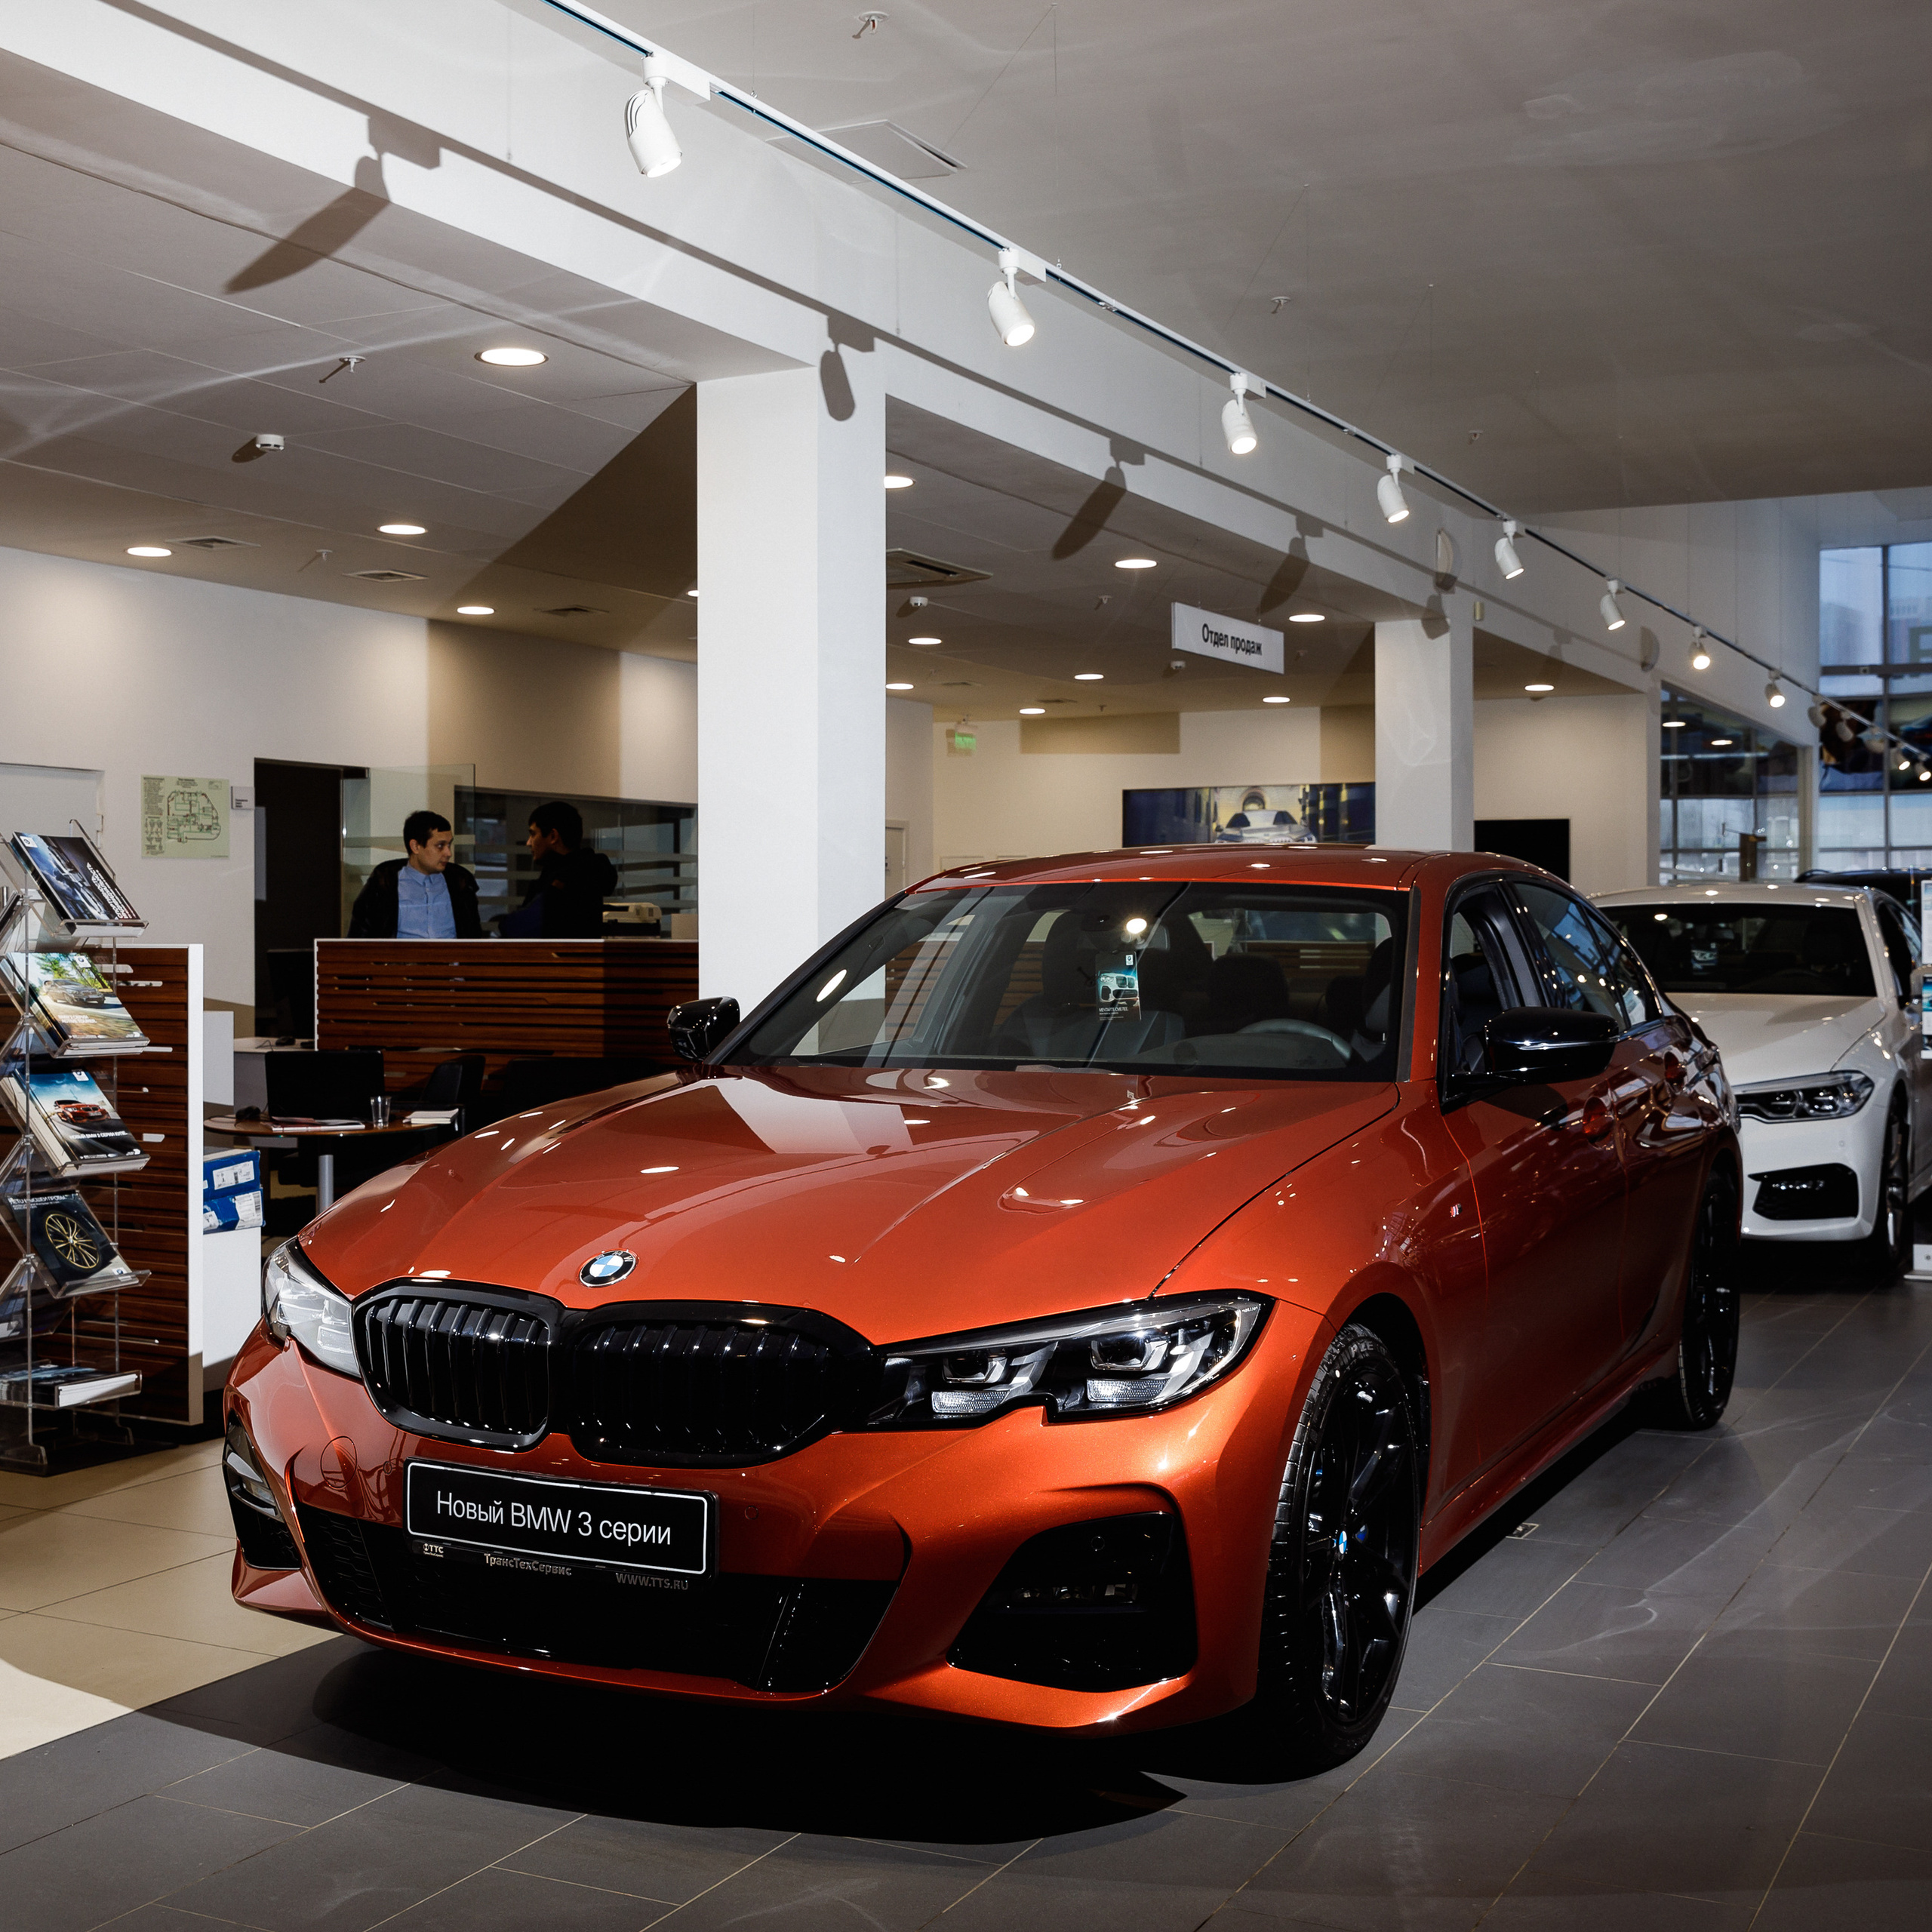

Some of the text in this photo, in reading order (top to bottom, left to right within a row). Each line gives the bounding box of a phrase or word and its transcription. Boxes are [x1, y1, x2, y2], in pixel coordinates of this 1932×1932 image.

[1201, 623, 1263, 656] Отдел продаж
[437, 1490, 672, 1546] Новый BMW 3 серии
[484, 1552, 572, 1577] ТрансТехСервис
[615, 1572, 689, 1591] WWW.TTS.RU
